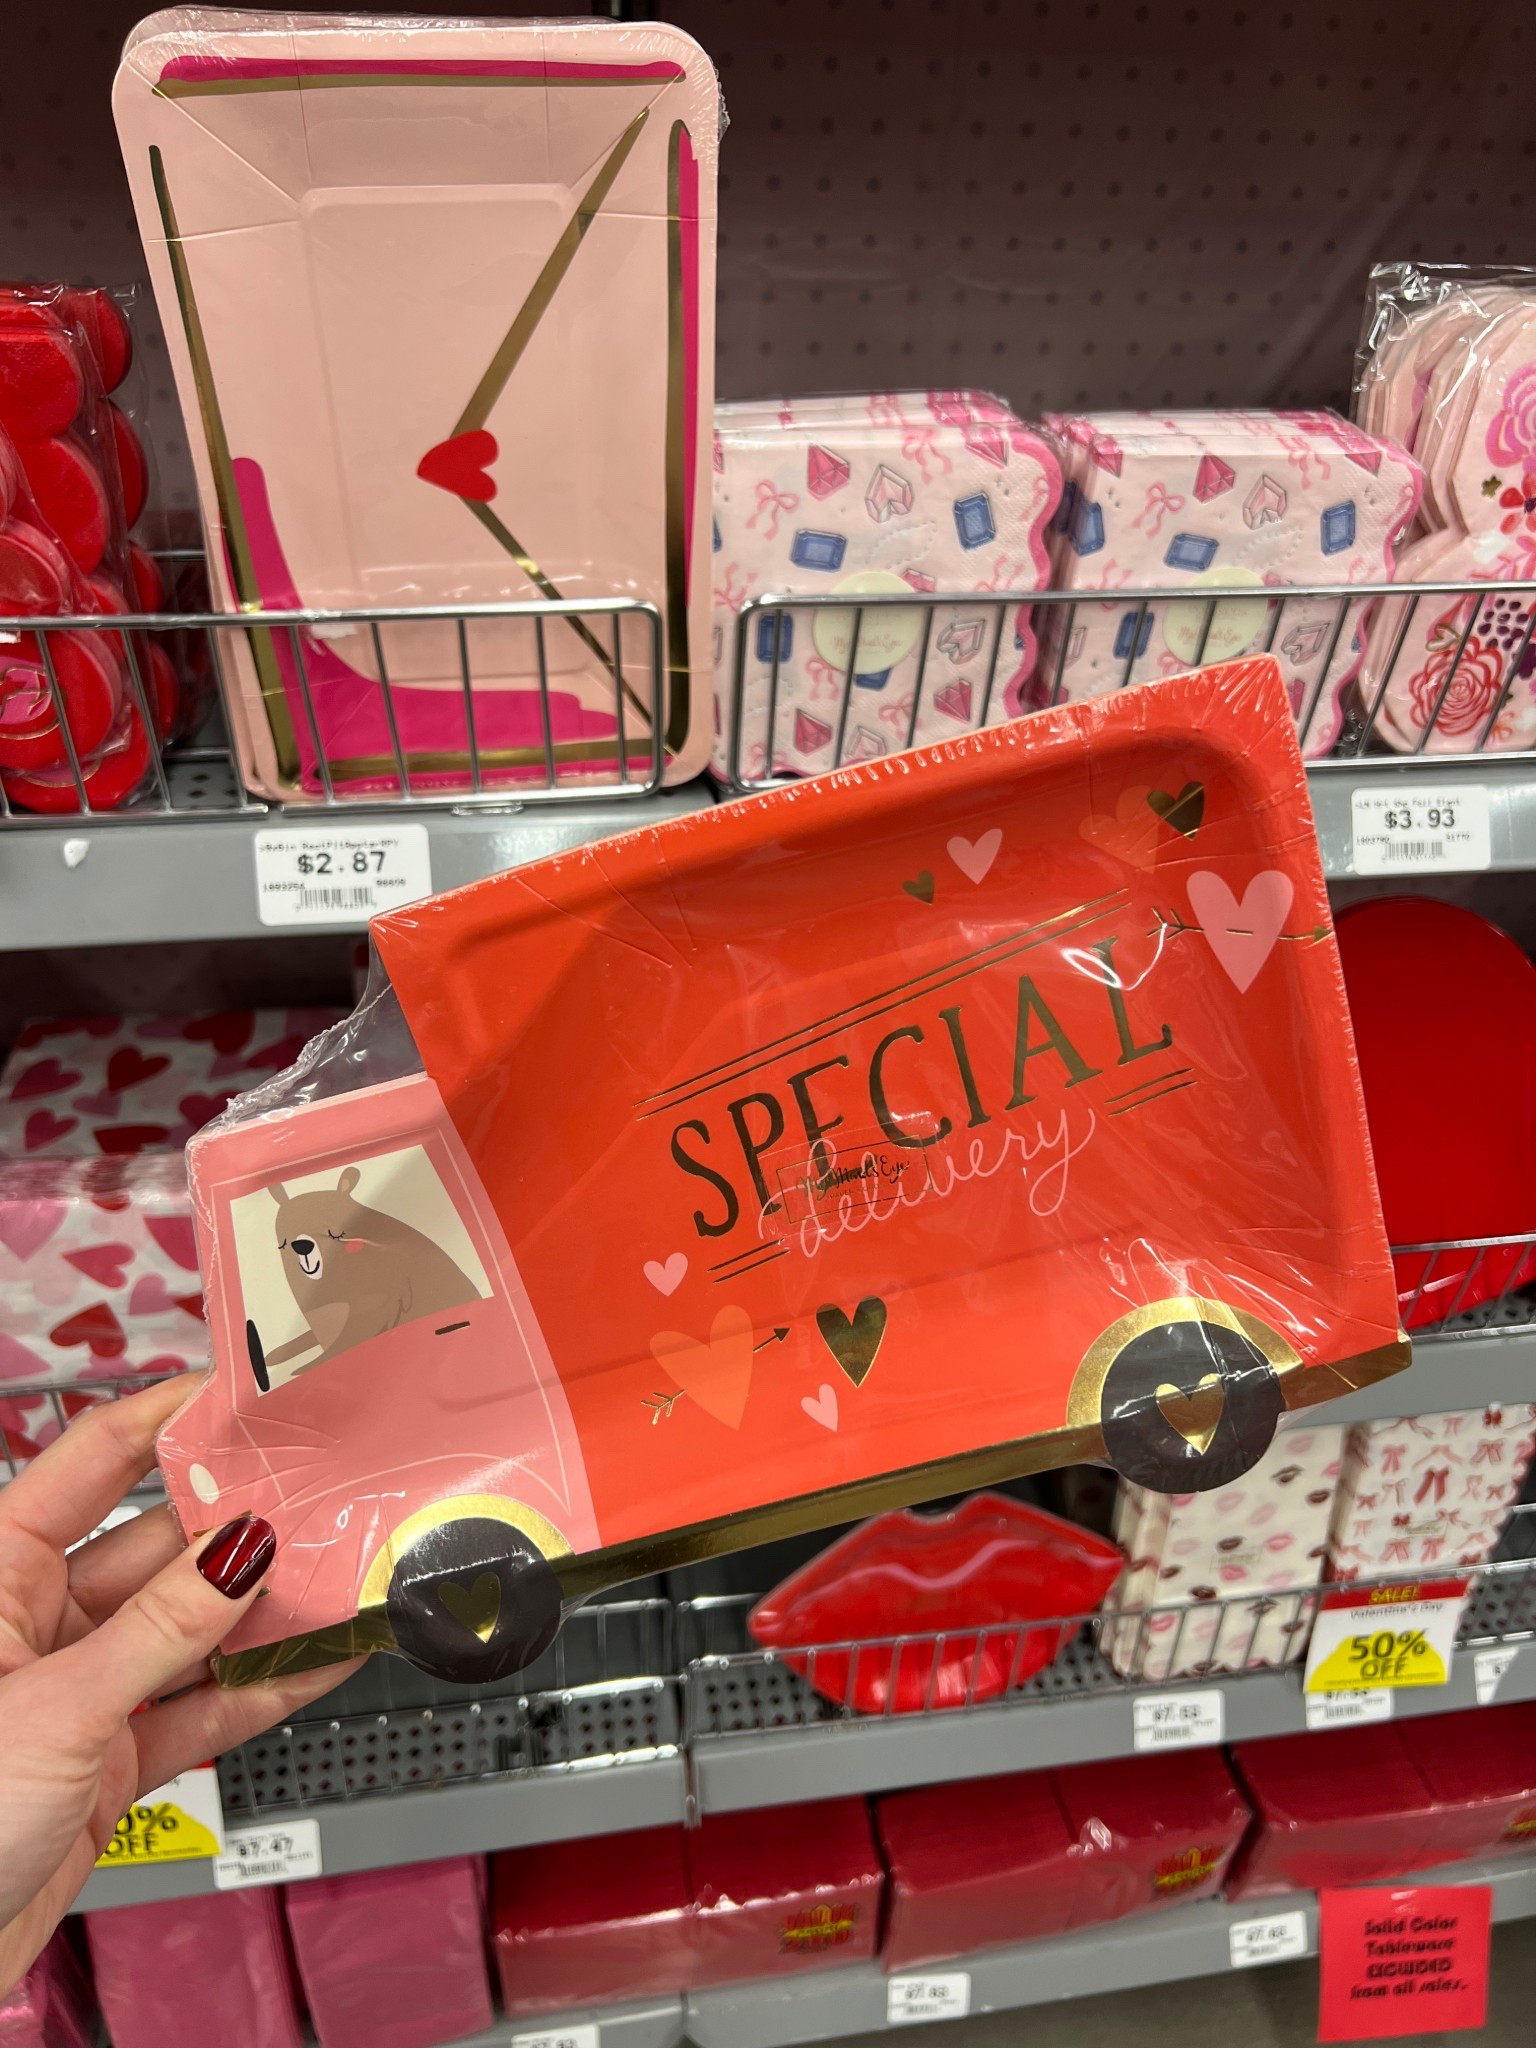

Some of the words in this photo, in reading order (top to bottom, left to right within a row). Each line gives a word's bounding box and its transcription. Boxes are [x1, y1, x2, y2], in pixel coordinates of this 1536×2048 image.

[1384, 809, 1455, 829] $3.93
[297, 851, 387, 875] $2.87
[670, 936, 1173, 1239] SPECIAL
[757, 1107, 1096, 1258] delivery
[1369, 1585, 1421, 1605] SALE!
[1350, 1603, 1418, 1619] Valentine's
[1419, 1600, 1444, 1614] Day
[1348, 1627, 1429, 1663] 50%
[1360, 1657, 1408, 1679] OFF
[115, 1802, 177, 1835] 0%
[104, 1832, 160, 1858] OFF
[1364, 1917, 1406, 1936] Solid
[1409, 1915, 1459, 1934] Color
[1364, 1937, 1456, 1957] Tableware
[1365, 1956, 1454, 1980] EXCLUDED
[1350, 1982, 1389, 2001] from
[1392, 1978, 1415, 1996] all
[1418, 1977, 1468, 1995] sales.
